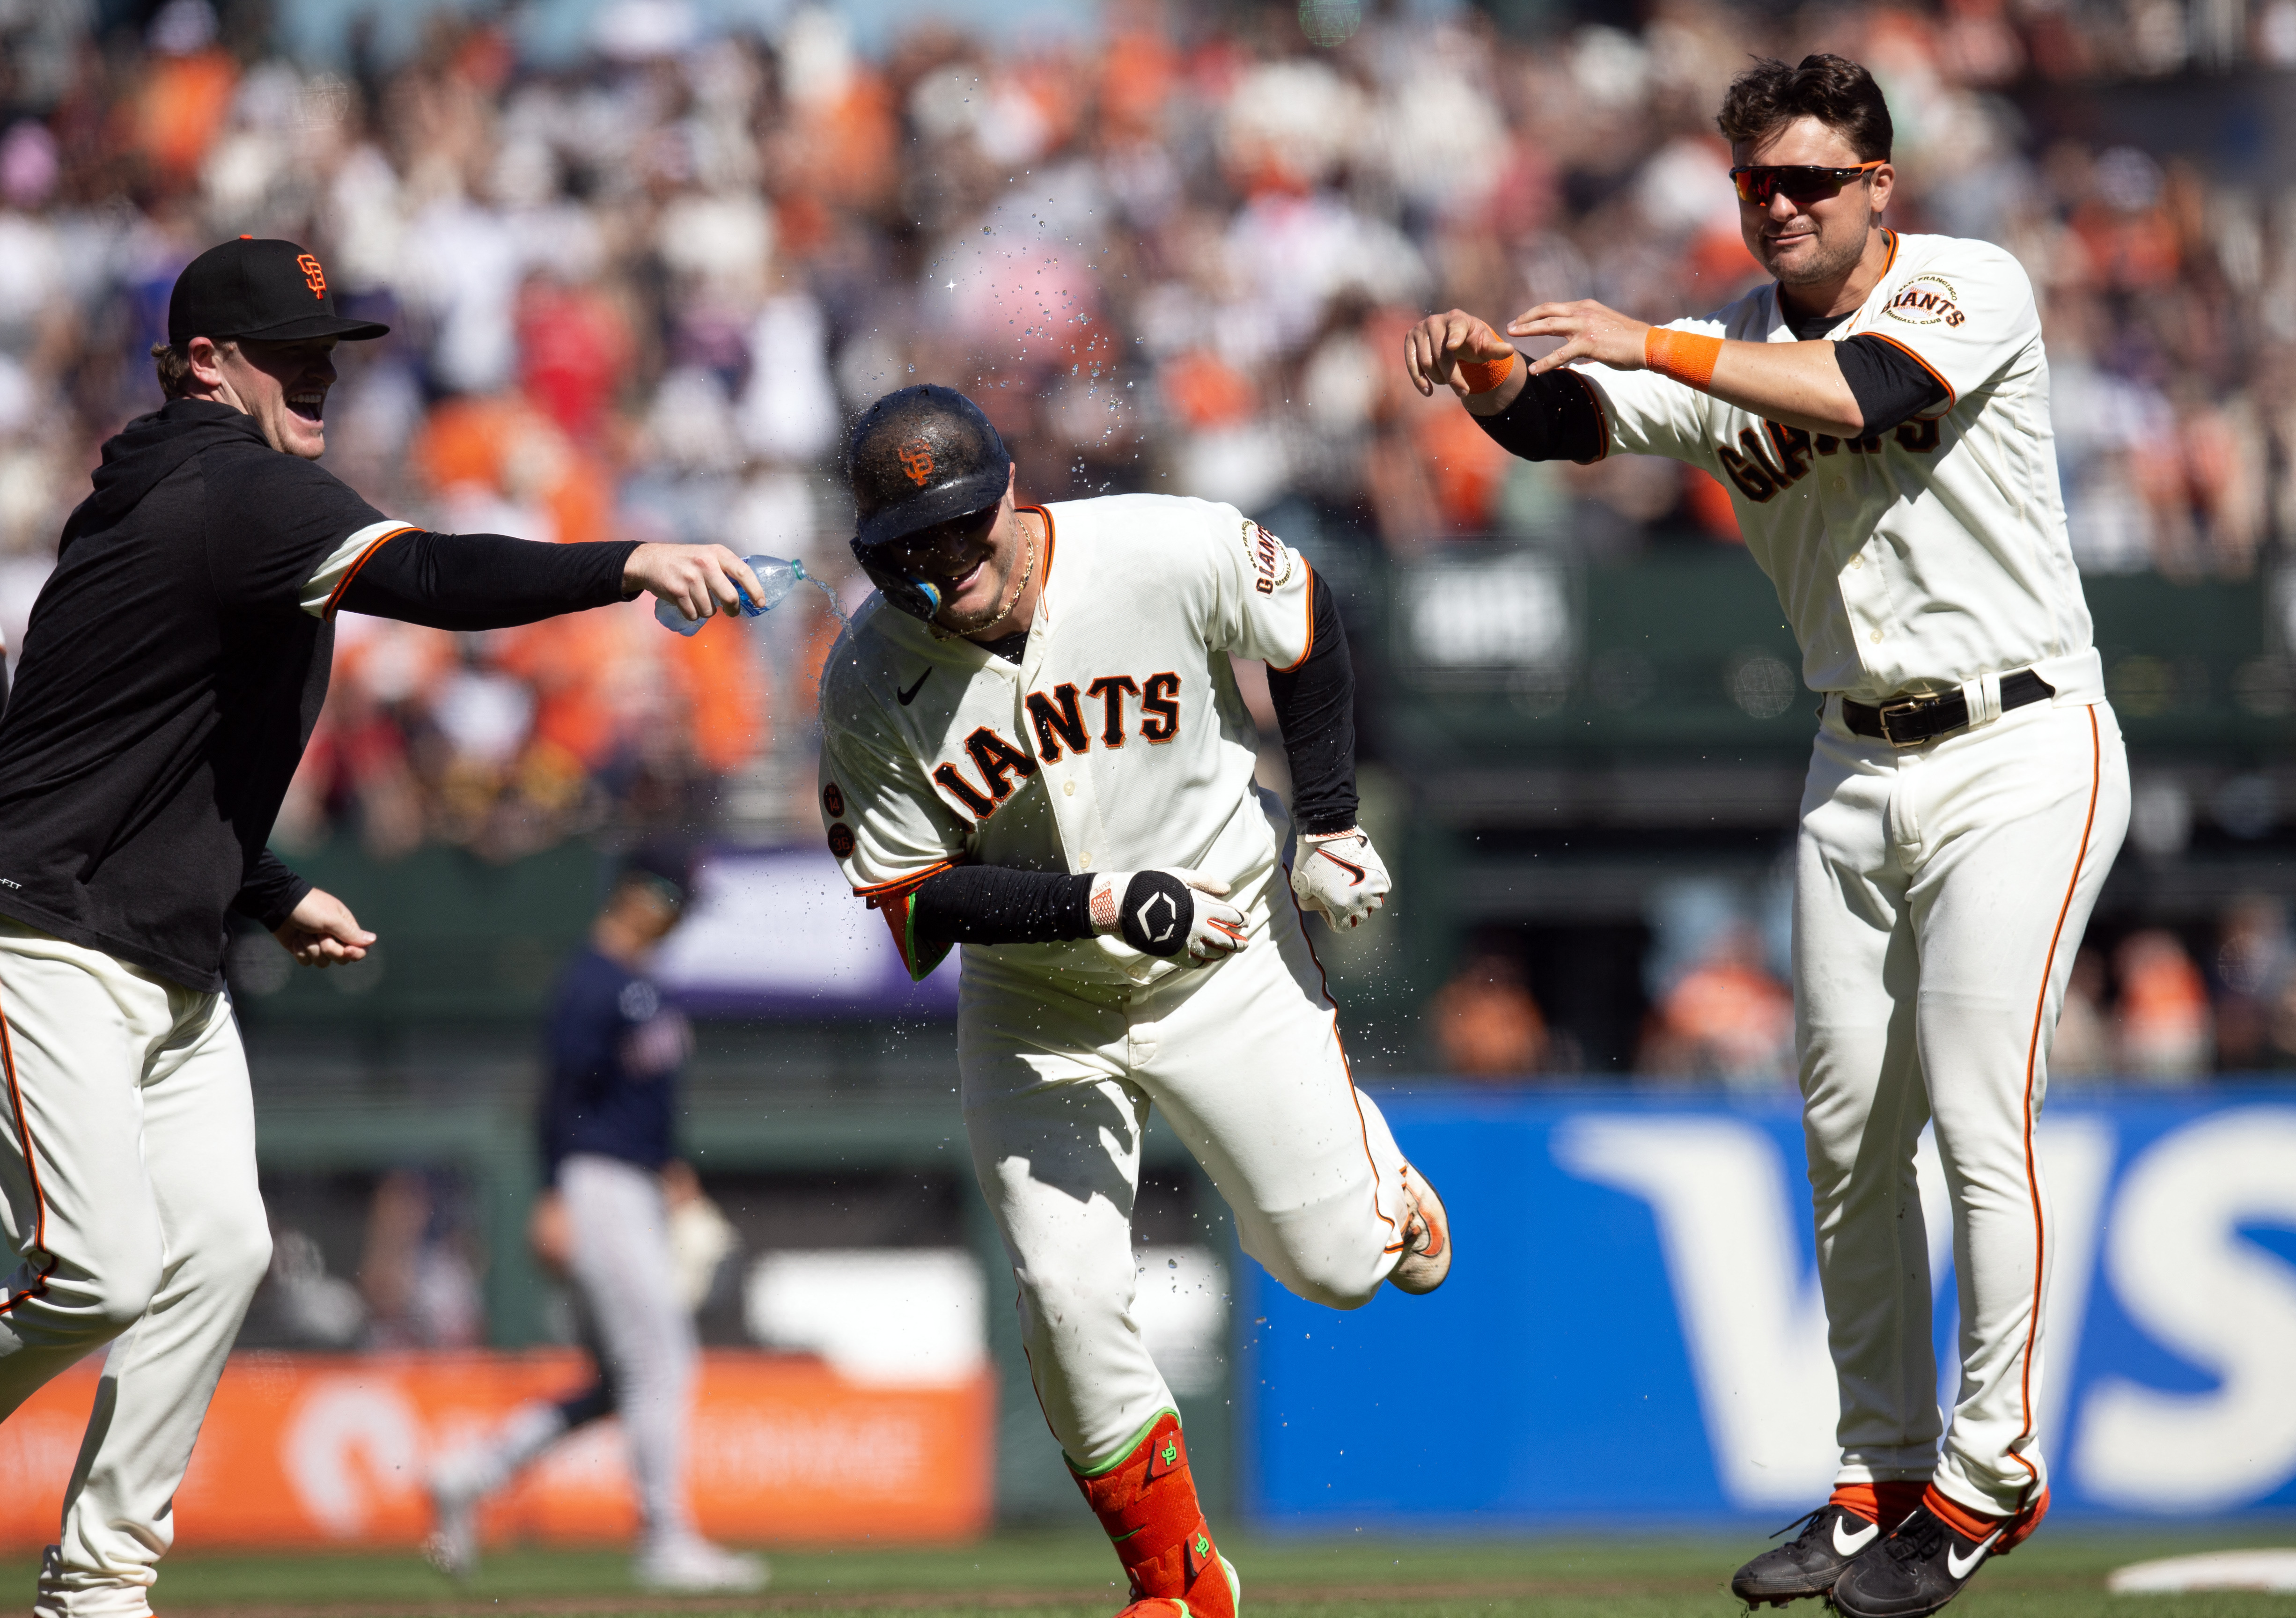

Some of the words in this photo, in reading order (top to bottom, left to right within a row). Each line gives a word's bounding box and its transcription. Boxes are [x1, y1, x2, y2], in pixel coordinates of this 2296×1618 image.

[1898, 280, 1914, 293] SAN
[1918, 276, 1957, 301] FRANCISCO
[1886, 309, 1918, 324] BASEBALL
[1246, 551, 1258, 569] SAN
[931, 671, 1182, 834] IANTS
[828, 797, 840, 812] 14
[833, 836, 851, 851] 36
[1093, 881, 1111, 894] ELITE
